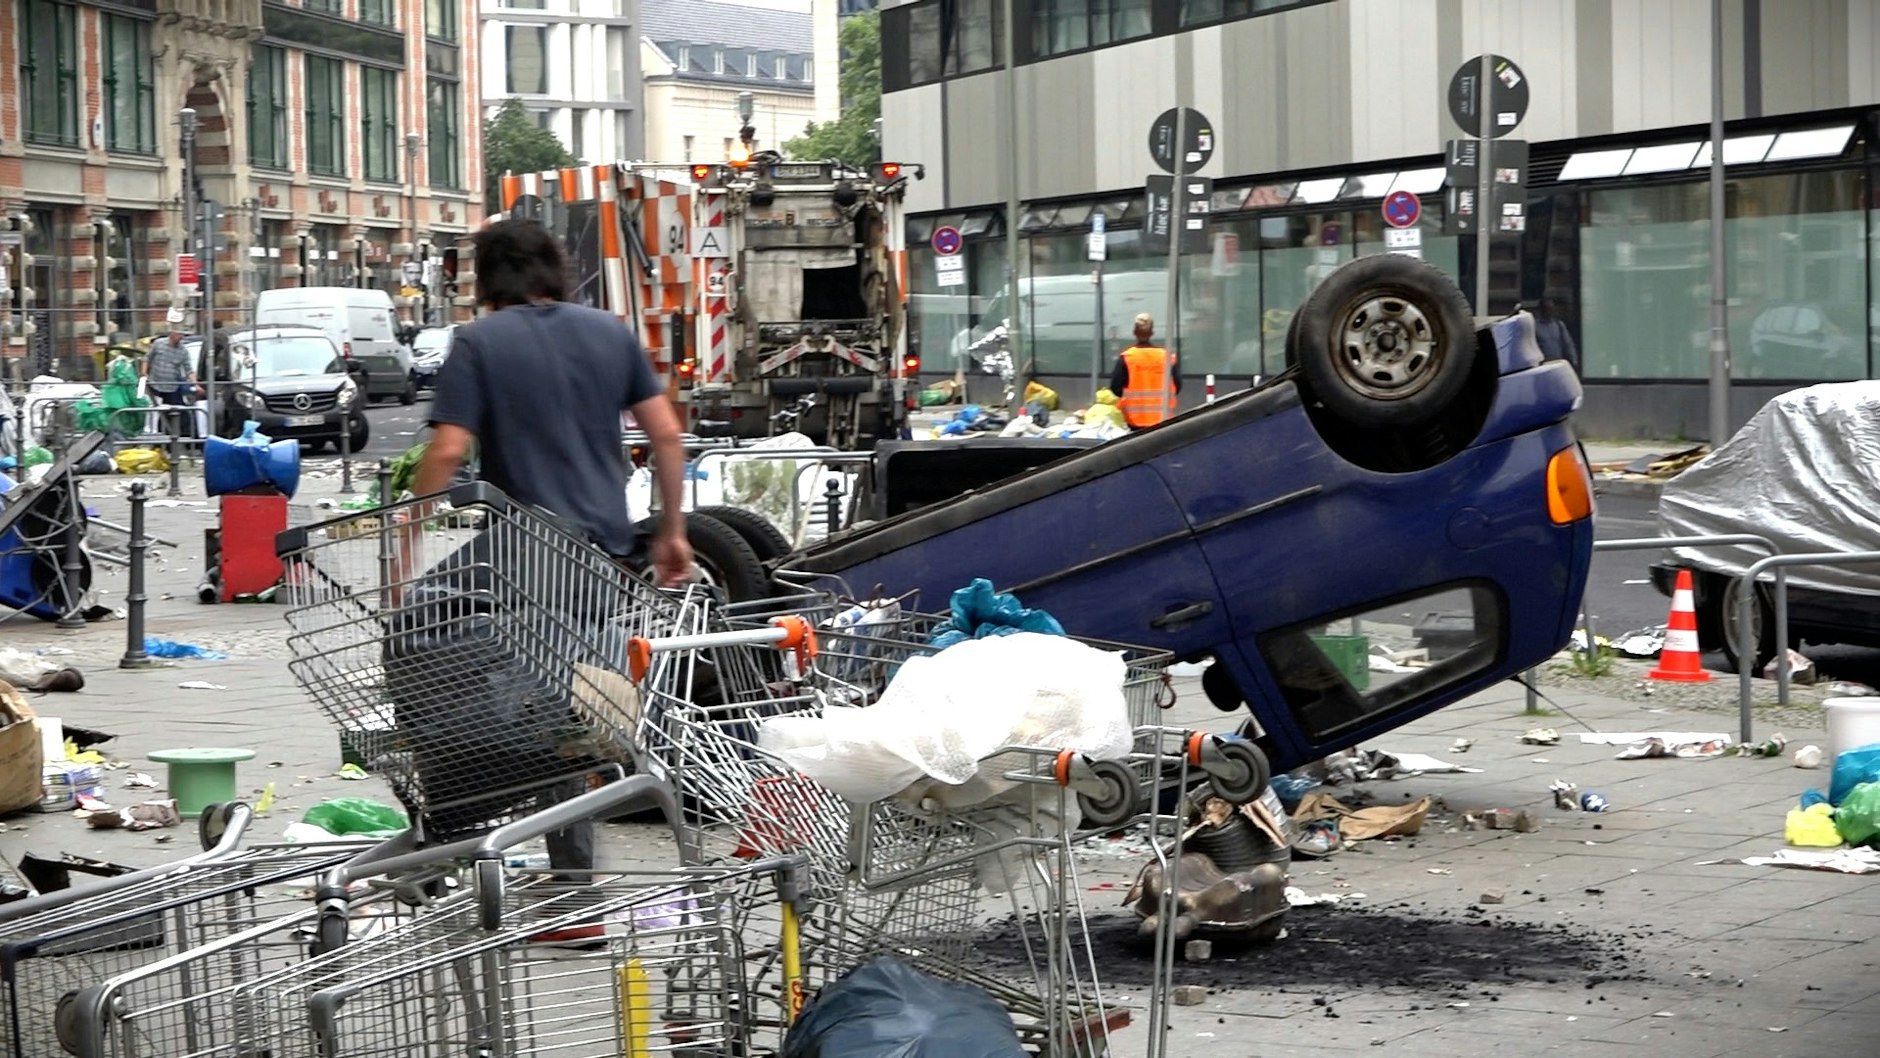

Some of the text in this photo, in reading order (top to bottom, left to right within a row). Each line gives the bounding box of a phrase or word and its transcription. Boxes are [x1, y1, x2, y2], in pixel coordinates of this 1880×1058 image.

[669, 225, 684, 253] 94
[699, 230, 721, 253] A
[709, 275, 724, 286] 94
